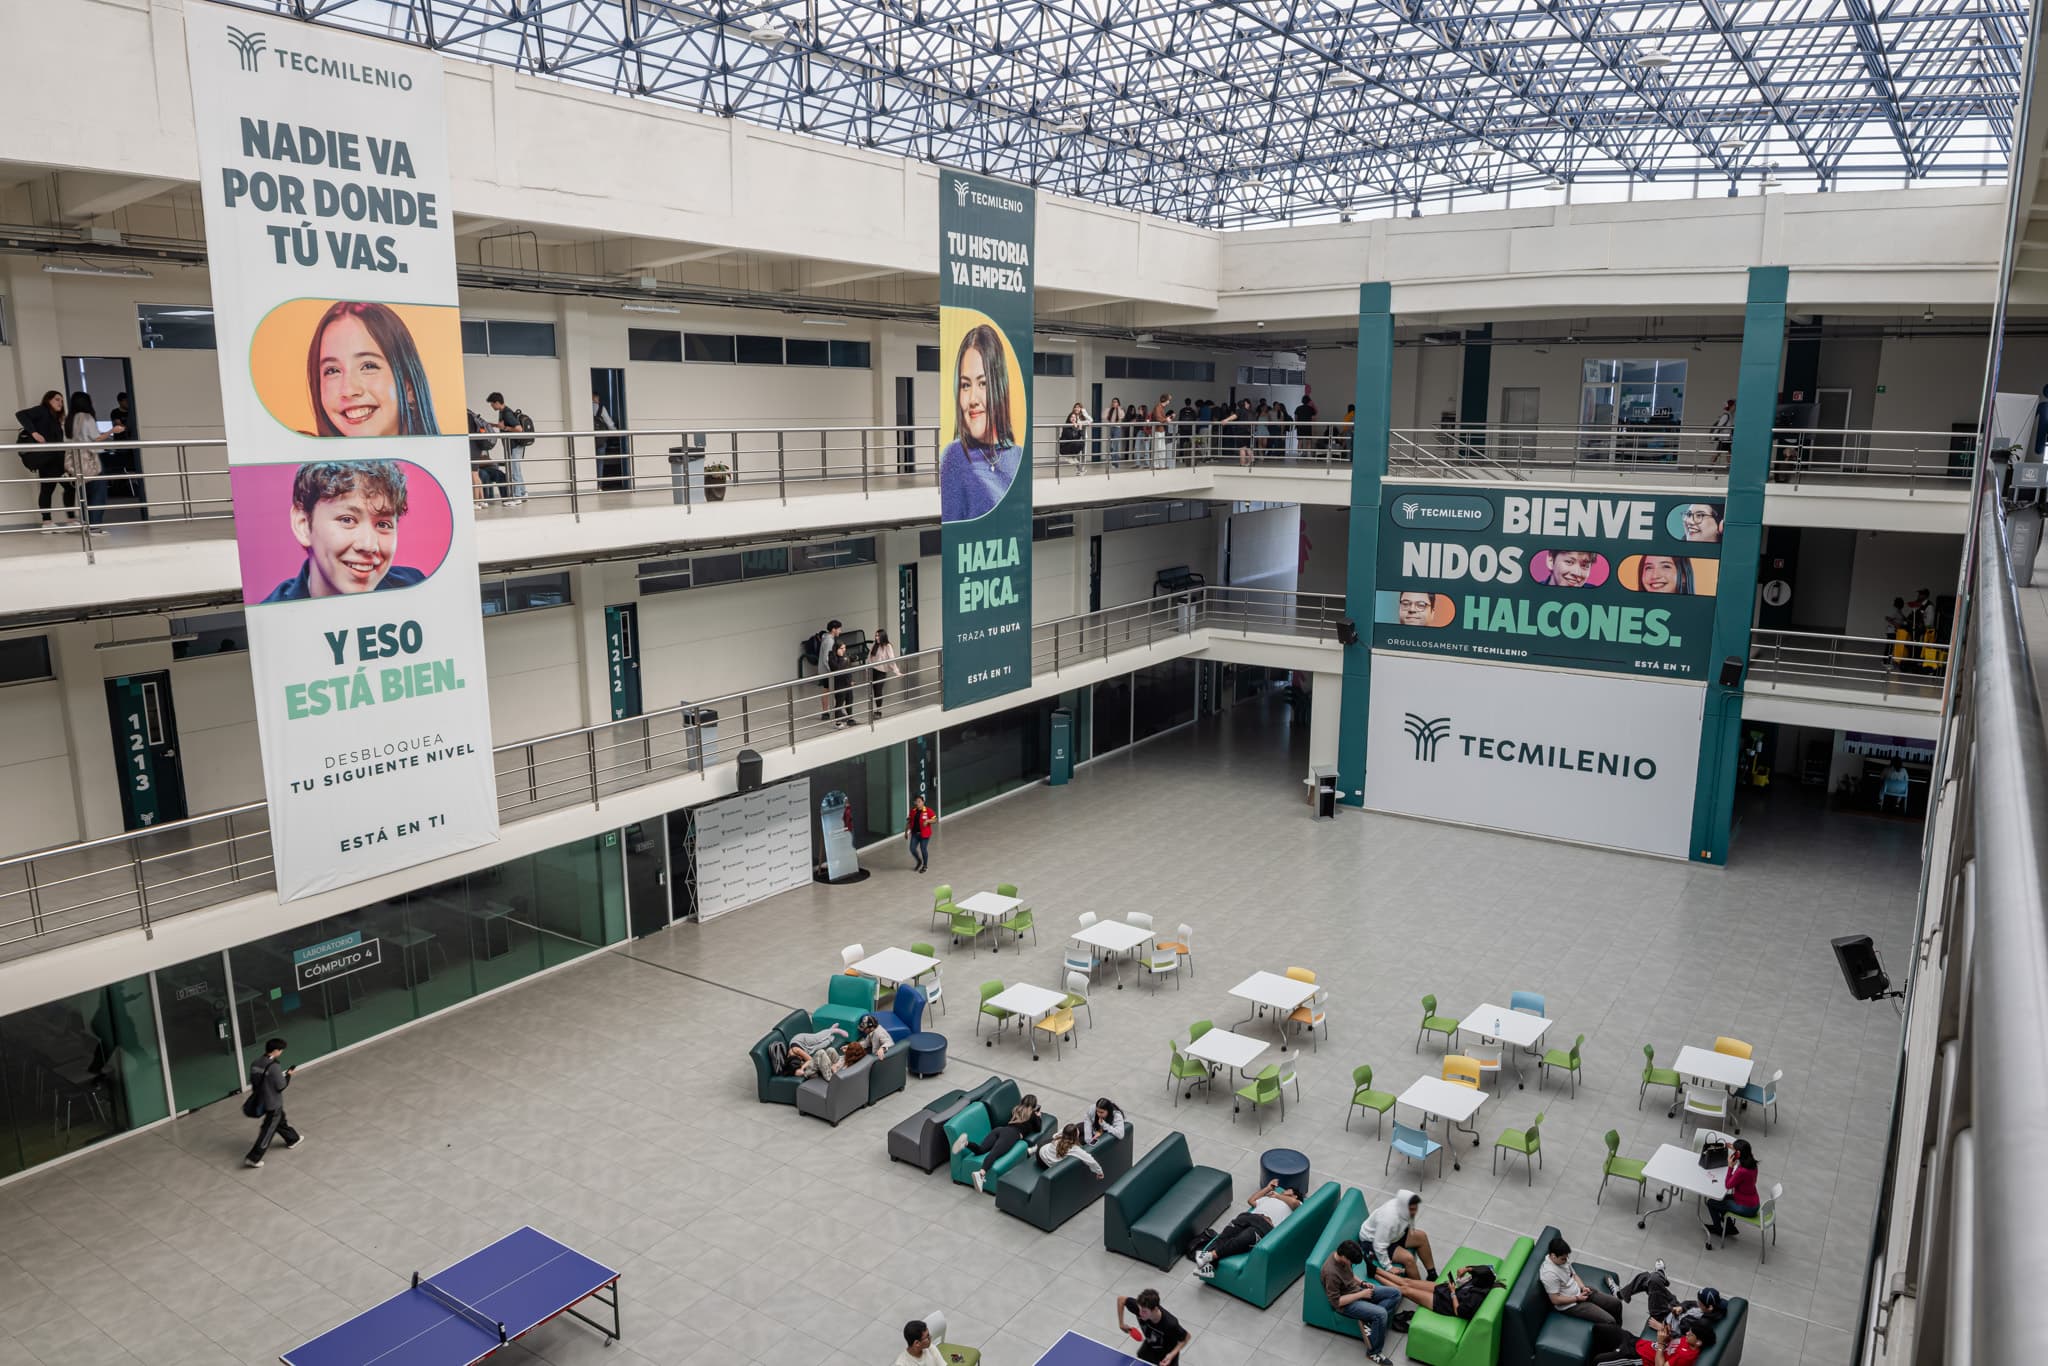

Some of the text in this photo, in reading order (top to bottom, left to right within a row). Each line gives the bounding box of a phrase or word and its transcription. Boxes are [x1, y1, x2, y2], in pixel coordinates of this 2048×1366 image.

[274, 48, 413, 91] TECMILENIO
[241, 116, 416, 179] NADIE VA
[222, 168, 438, 229] POR DONDE
[971, 191, 1023, 213] TECMILENIO
[266, 220, 409, 273] TÚ VAS.
[948, 232, 1029, 266] TU HISTORIA
[951, 261, 1026, 293] YA EMPEZÓ.
[1420, 508, 1482, 519] TECMILENIO
[1503, 496, 1656, 541] BIENVE
[958, 536, 1020, 574] HAZLA
[1402, 541, 1523, 584] NIDOS
[959, 575, 1019, 614] ÉPICA.
[957, 622, 1020, 643] TRAZA TU RUTA
[1463, 595, 1682, 648] HALCONES.
[325, 620, 423, 665] Y ESO
[1387, 637, 1528, 657] ORGULLOSAMENTE TECMILENIO
[611, 633, 622, 692] 1212
[968, 665, 1011, 684] ESTÁ EN TI
[1634, 658, 1690, 672] ESTÁ EN TI
[285, 658, 465, 720] ESTÁ BIEN.
[128, 713, 150, 792] 1213
[291, 742, 476, 794] TU SIGUIENTE NIVEL
[325, 733, 445, 769] DESBLOQUEA
[1459, 735, 1657, 780] TECMILENIO
[340, 814, 446, 852] ESTÁ EN TI
[303, 937, 353, 958] LABORATORIO
[305, 949, 373, 978] CÓMPUTO 4
